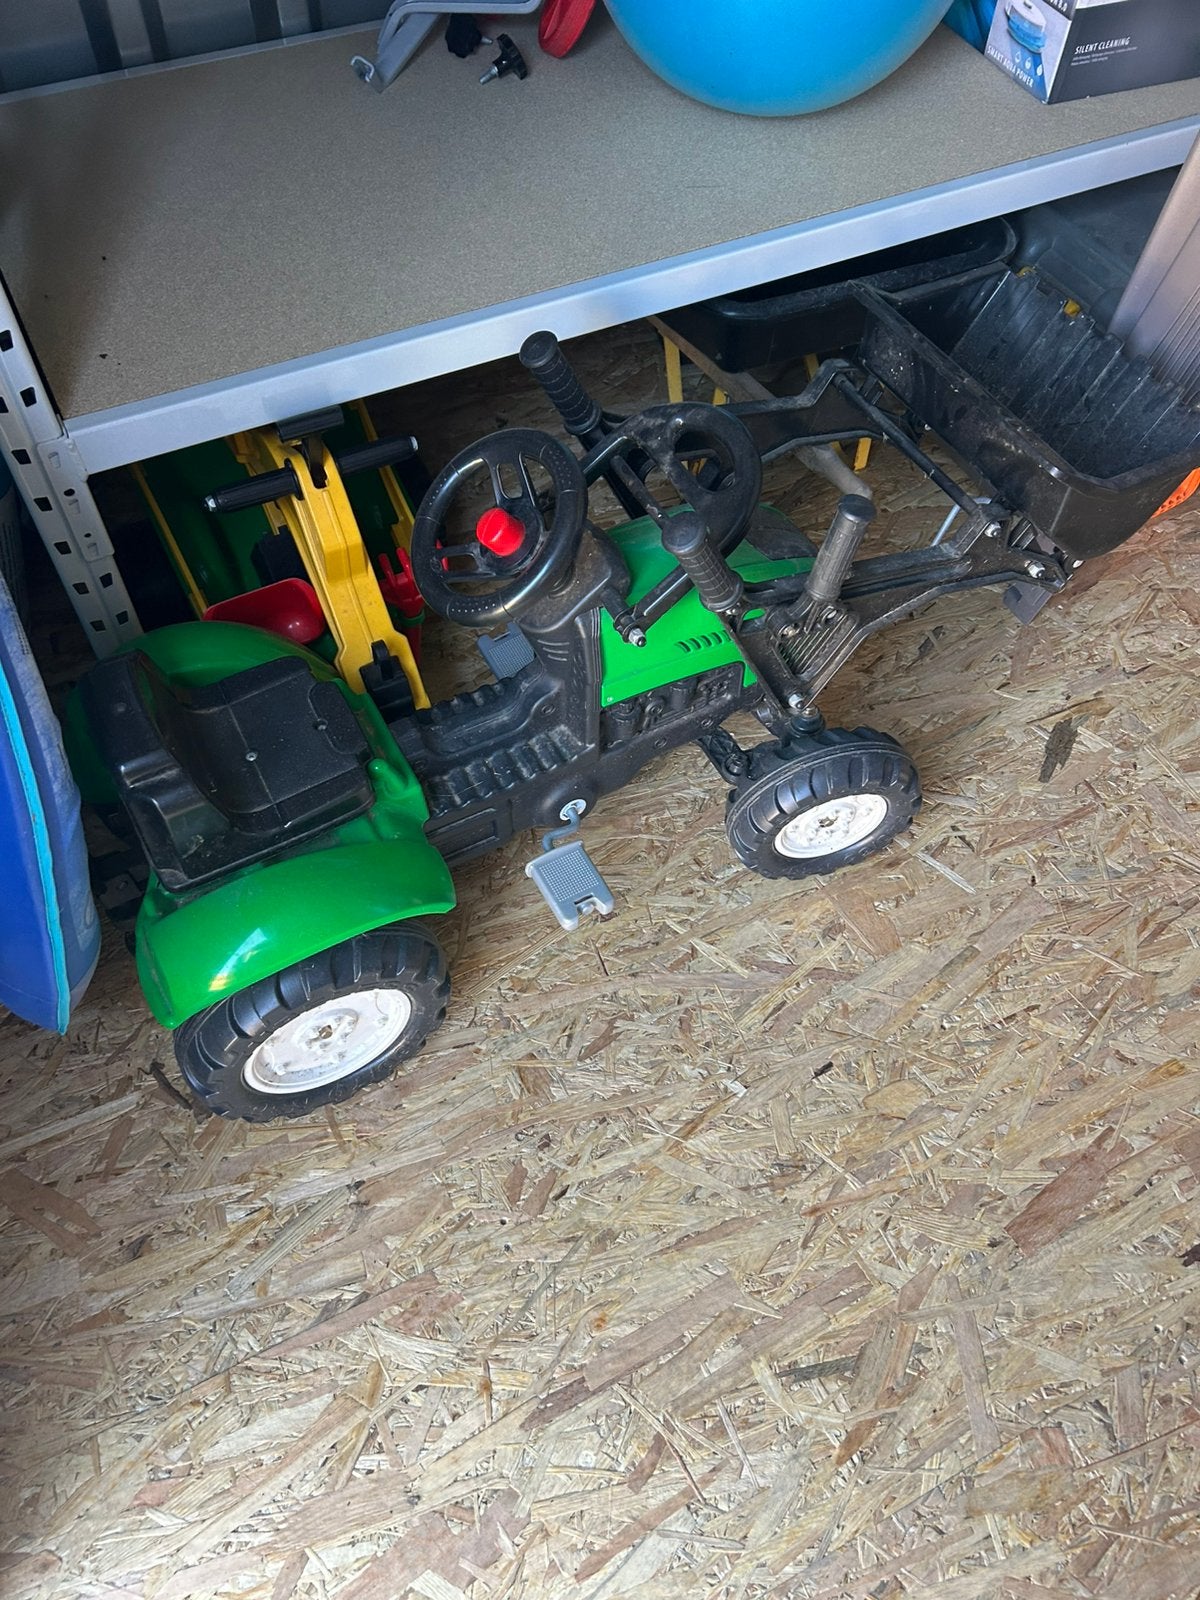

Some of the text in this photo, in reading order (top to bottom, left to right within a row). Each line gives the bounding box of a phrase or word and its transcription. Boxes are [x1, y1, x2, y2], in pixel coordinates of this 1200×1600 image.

[1074, 42, 1098, 54] SILENT
[1098, 36, 1131, 50] CLEANING
[987, 45, 1034, 88] SMART AQUA POWER
